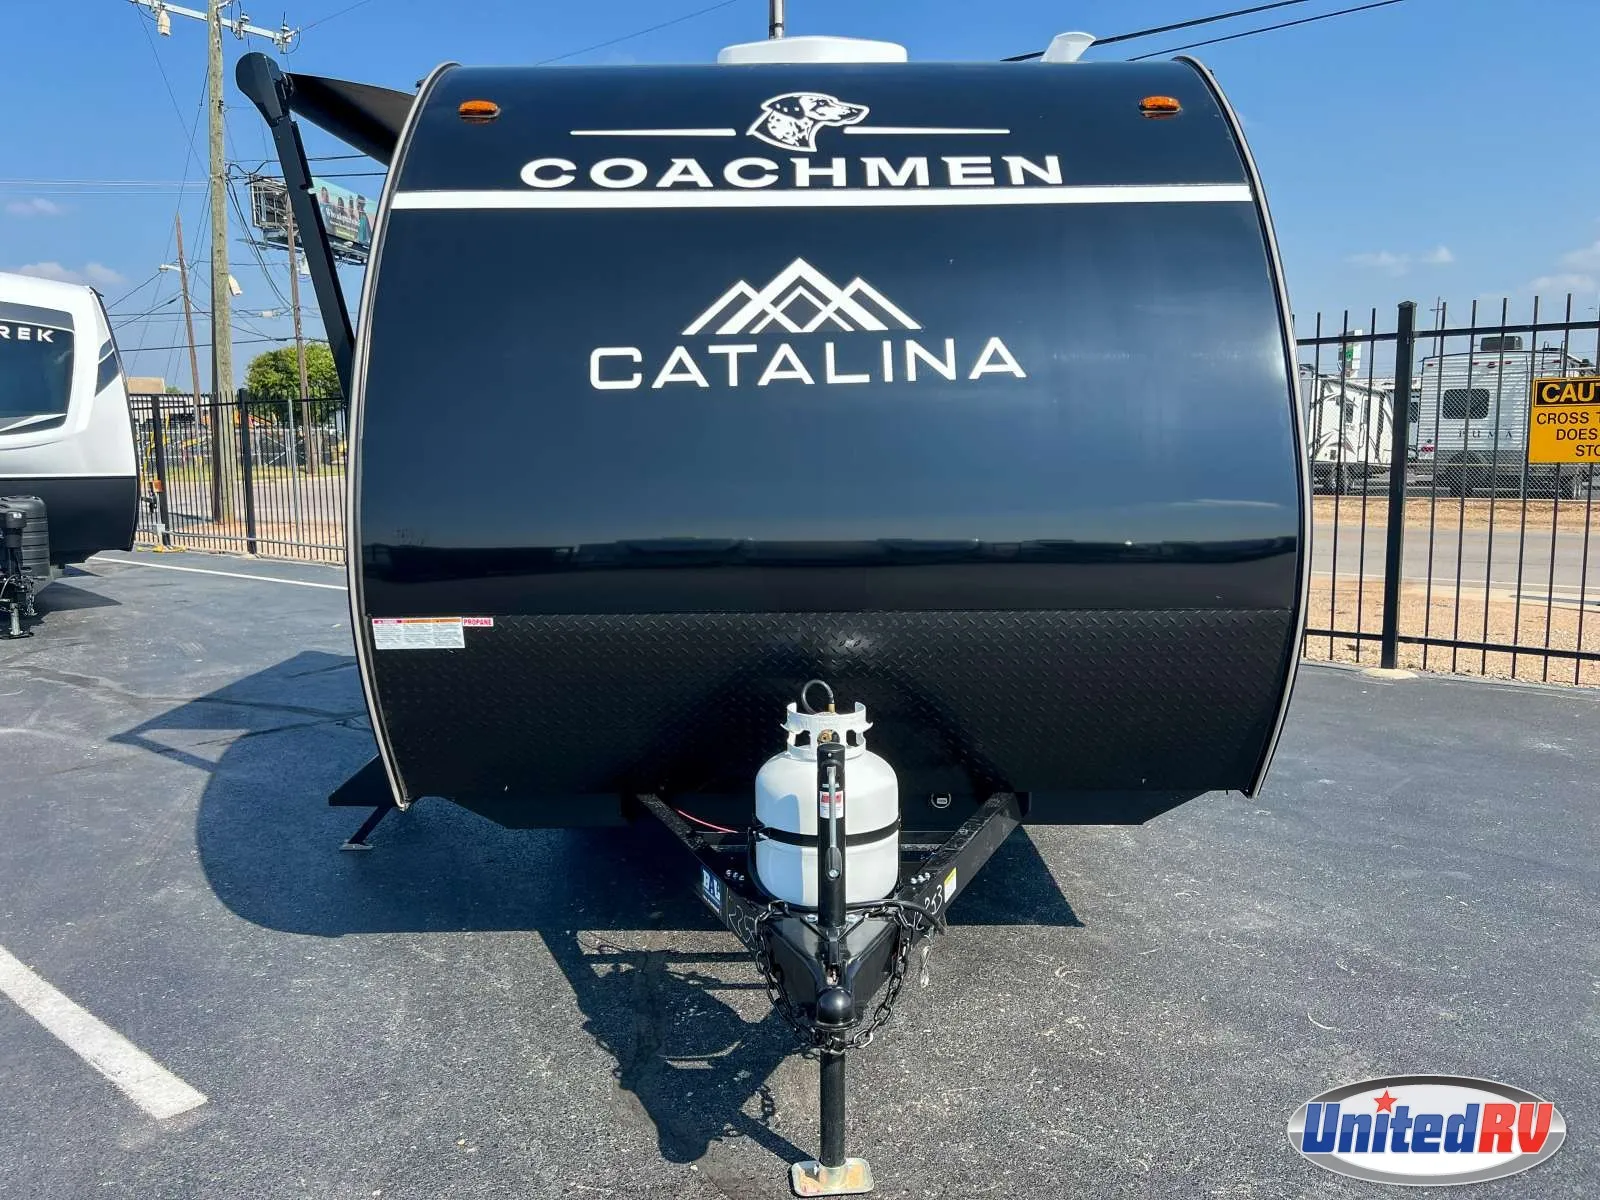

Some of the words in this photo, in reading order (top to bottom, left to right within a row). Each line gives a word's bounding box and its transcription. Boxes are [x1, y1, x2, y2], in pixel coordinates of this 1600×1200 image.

[520, 155, 1063, 188] COACHMEN
[0, 325, 54, 343] REK
[590, 336, 1027, 390] CATALINA
[1542, 382, 1600, 403] CAU
[1536, 411, 1590, 425] CROSS
[1556, 428, 1598, 441] DOES
